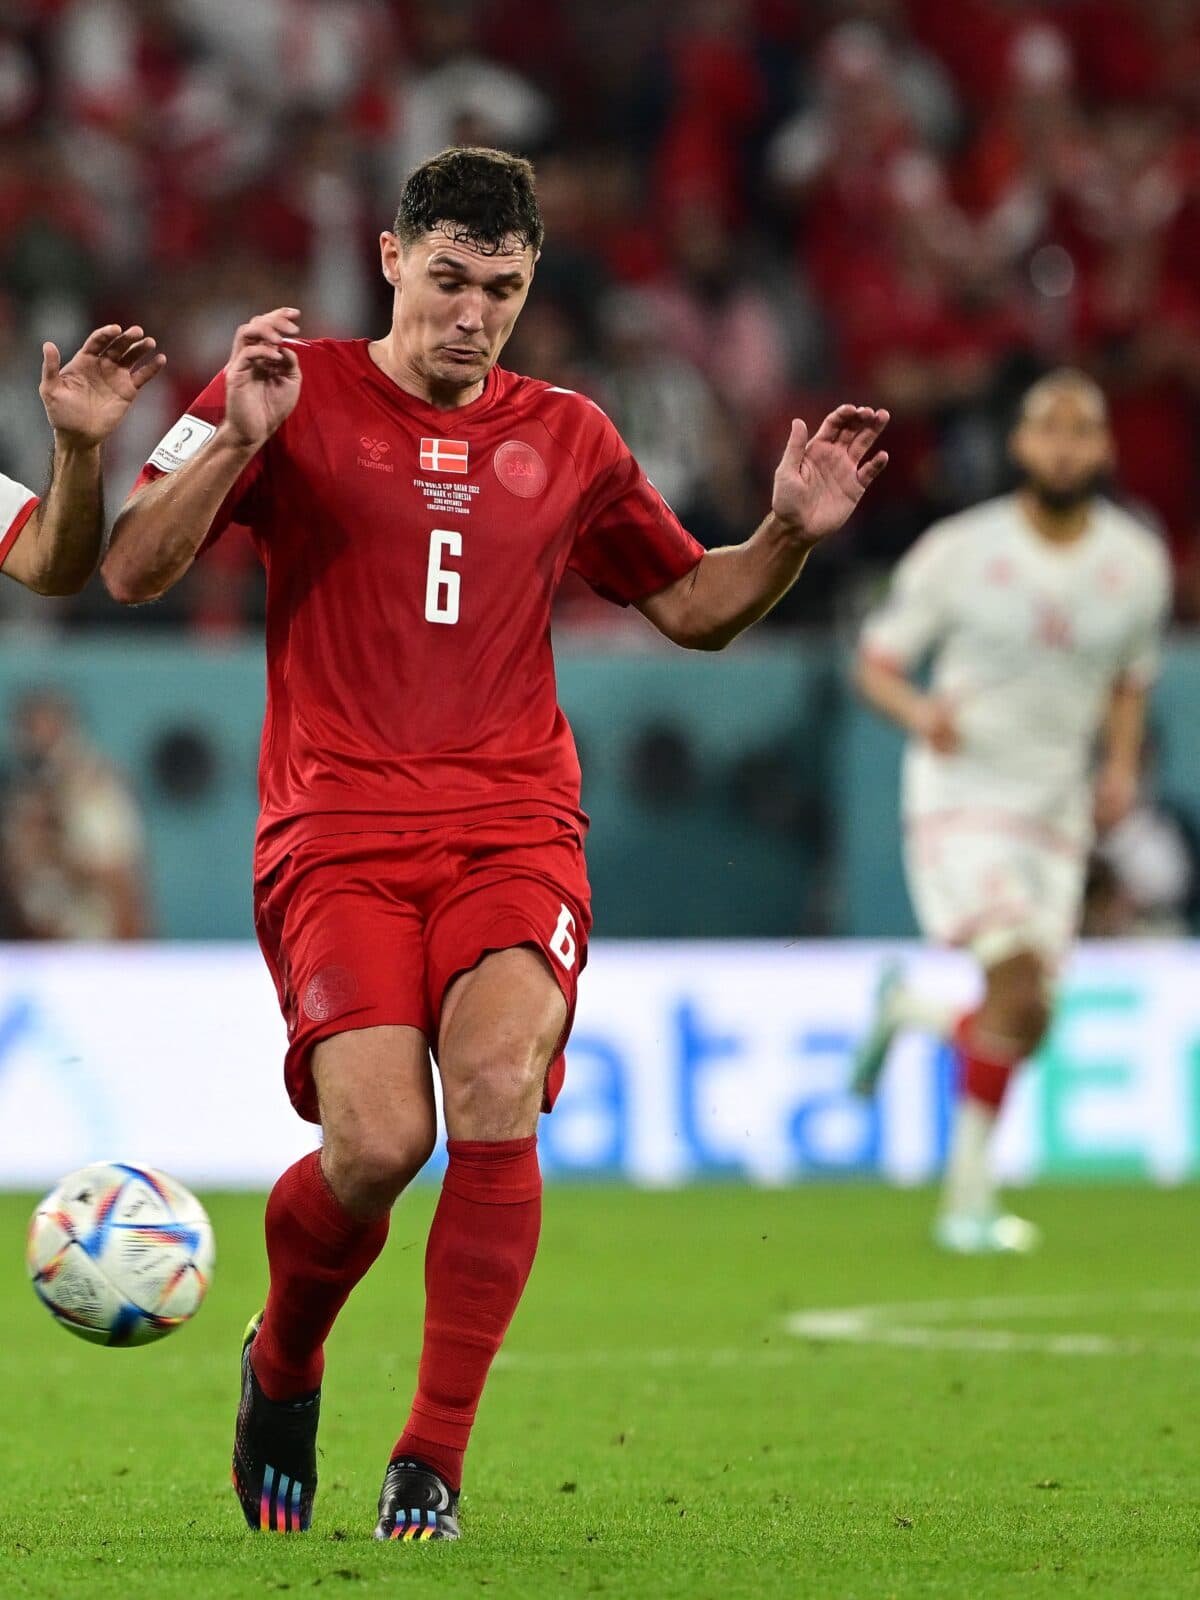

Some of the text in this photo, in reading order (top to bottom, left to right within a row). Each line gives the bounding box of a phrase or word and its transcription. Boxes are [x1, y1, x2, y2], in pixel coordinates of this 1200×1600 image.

[356, 456, 394, 473] hummel
[413, 479, 424, 488] FIFA
[424, 528, 463, 625] 6
[549, 903, 576, 972] 6
